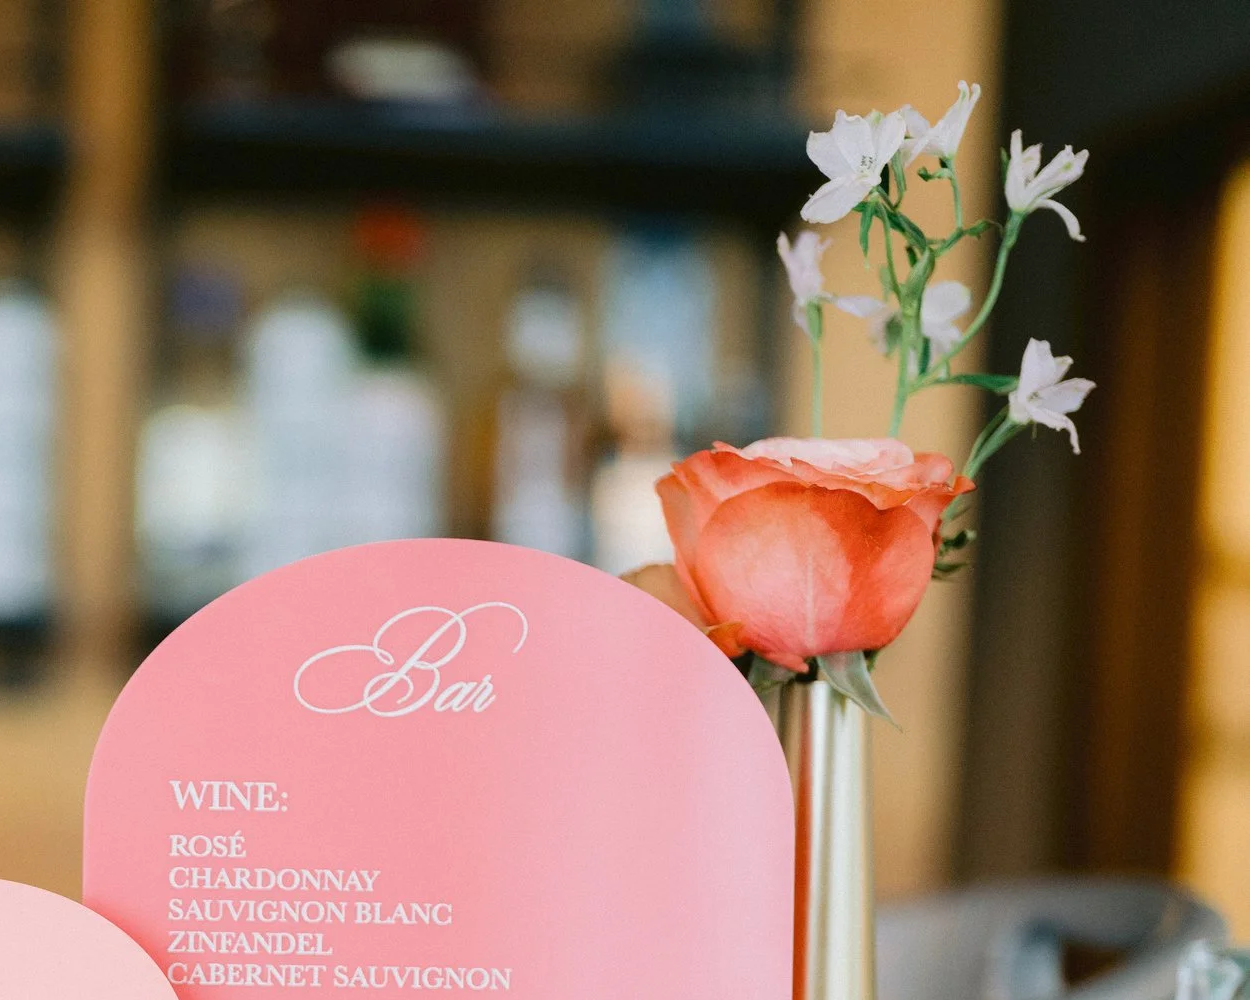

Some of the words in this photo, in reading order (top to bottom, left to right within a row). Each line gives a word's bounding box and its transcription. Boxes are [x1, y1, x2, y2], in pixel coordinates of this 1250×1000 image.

[293, 601, 528, 717] Bar
[169, 780, 288, 812] WINE:
[169, 830, 247, 858] ROSÉ
[169, 867, 381, 892] CHARDONNAY
[168, 898, 347, 923] SAUVIGNON
[354, 902, 452, 925] BLANC
[168, 931, 333, 956] ZINFANDEL
[169, 963, 326, 987] CABERNET
[333, 965, 512, 990] SAUVIGNON
